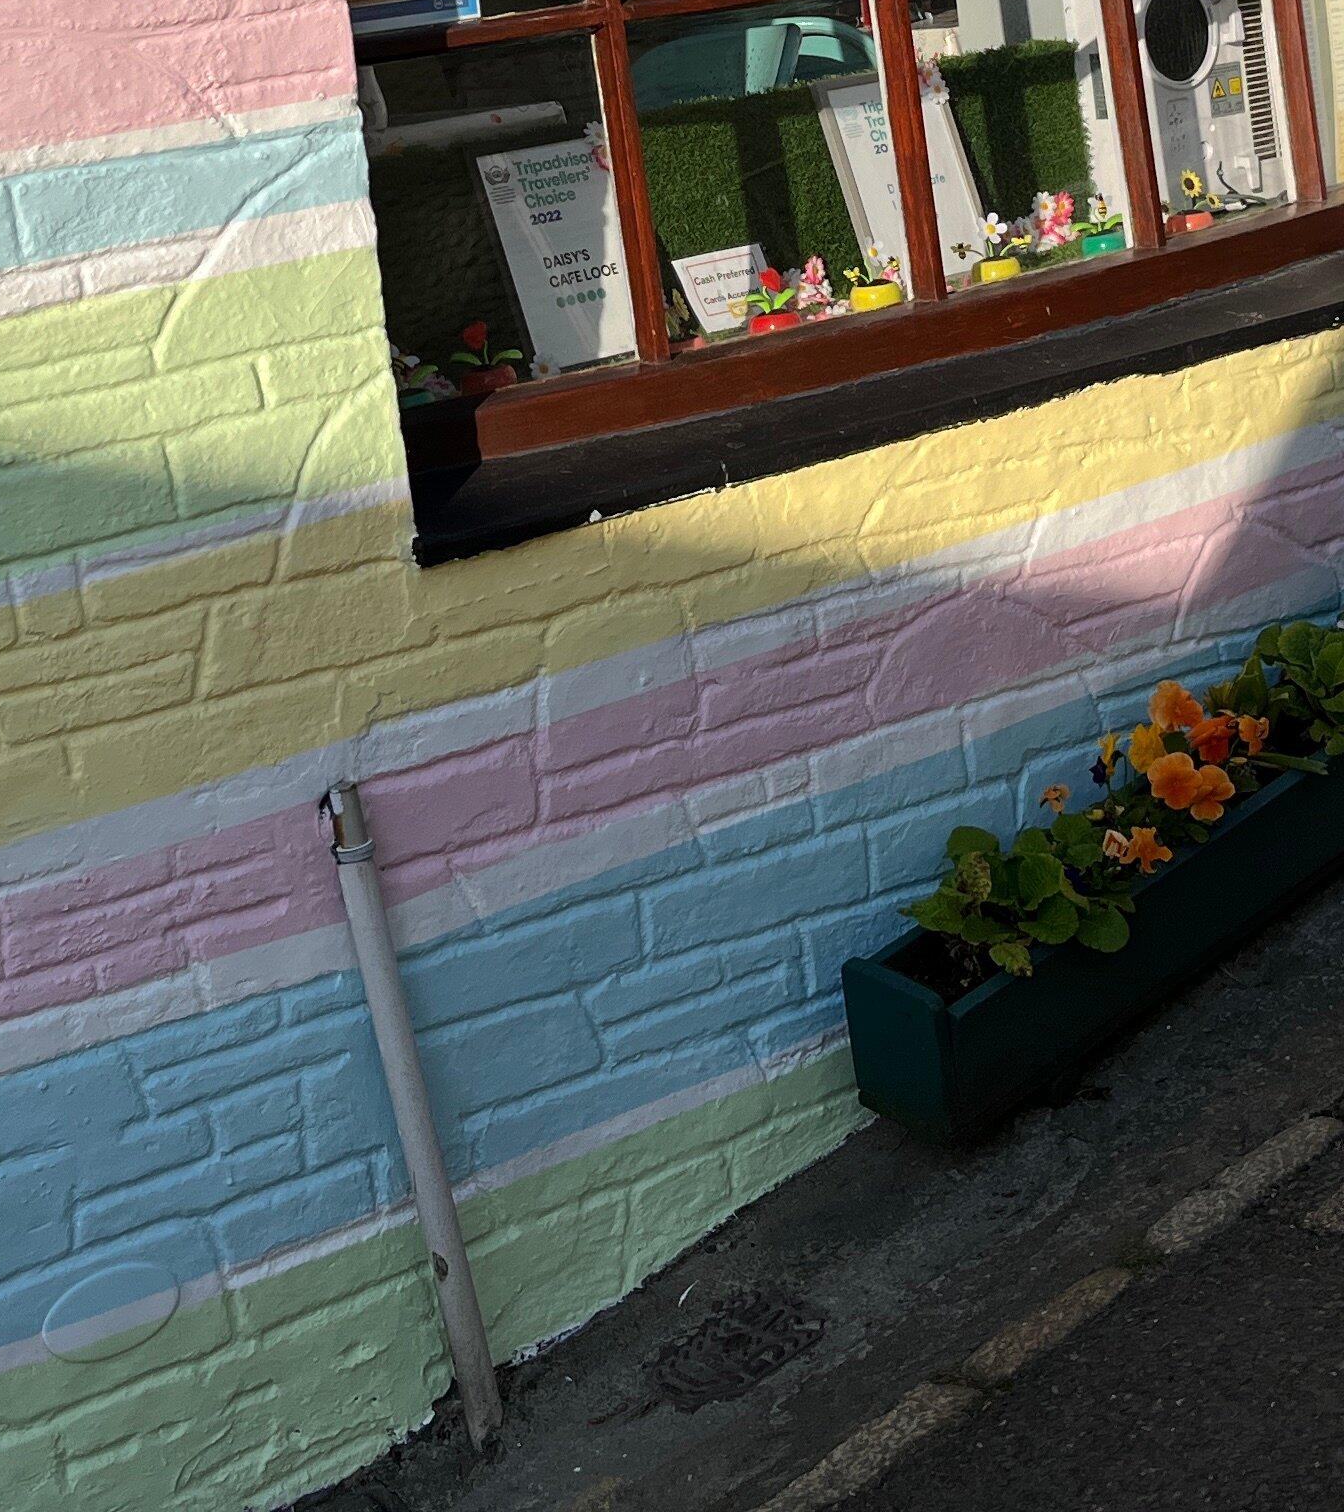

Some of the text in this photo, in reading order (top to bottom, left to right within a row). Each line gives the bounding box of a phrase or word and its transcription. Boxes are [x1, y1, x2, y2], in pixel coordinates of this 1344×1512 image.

[860, 100, 884, 114] Trip
[874, 143, 888, 155] 20
[513, 151, 594, 176] Tripadvisor
[517, 167, 591, 193] Travellers'
[524, 188, 577, 209] Choice
[529, 209, 563, 226] 2022
[542, 248, 591, 269] DAISY'S
[549, 262, 619, 288] CAFE LOOE
[693, 266, 756, 286] Cash Preferred
[703, 294, 727, 305] Cards
